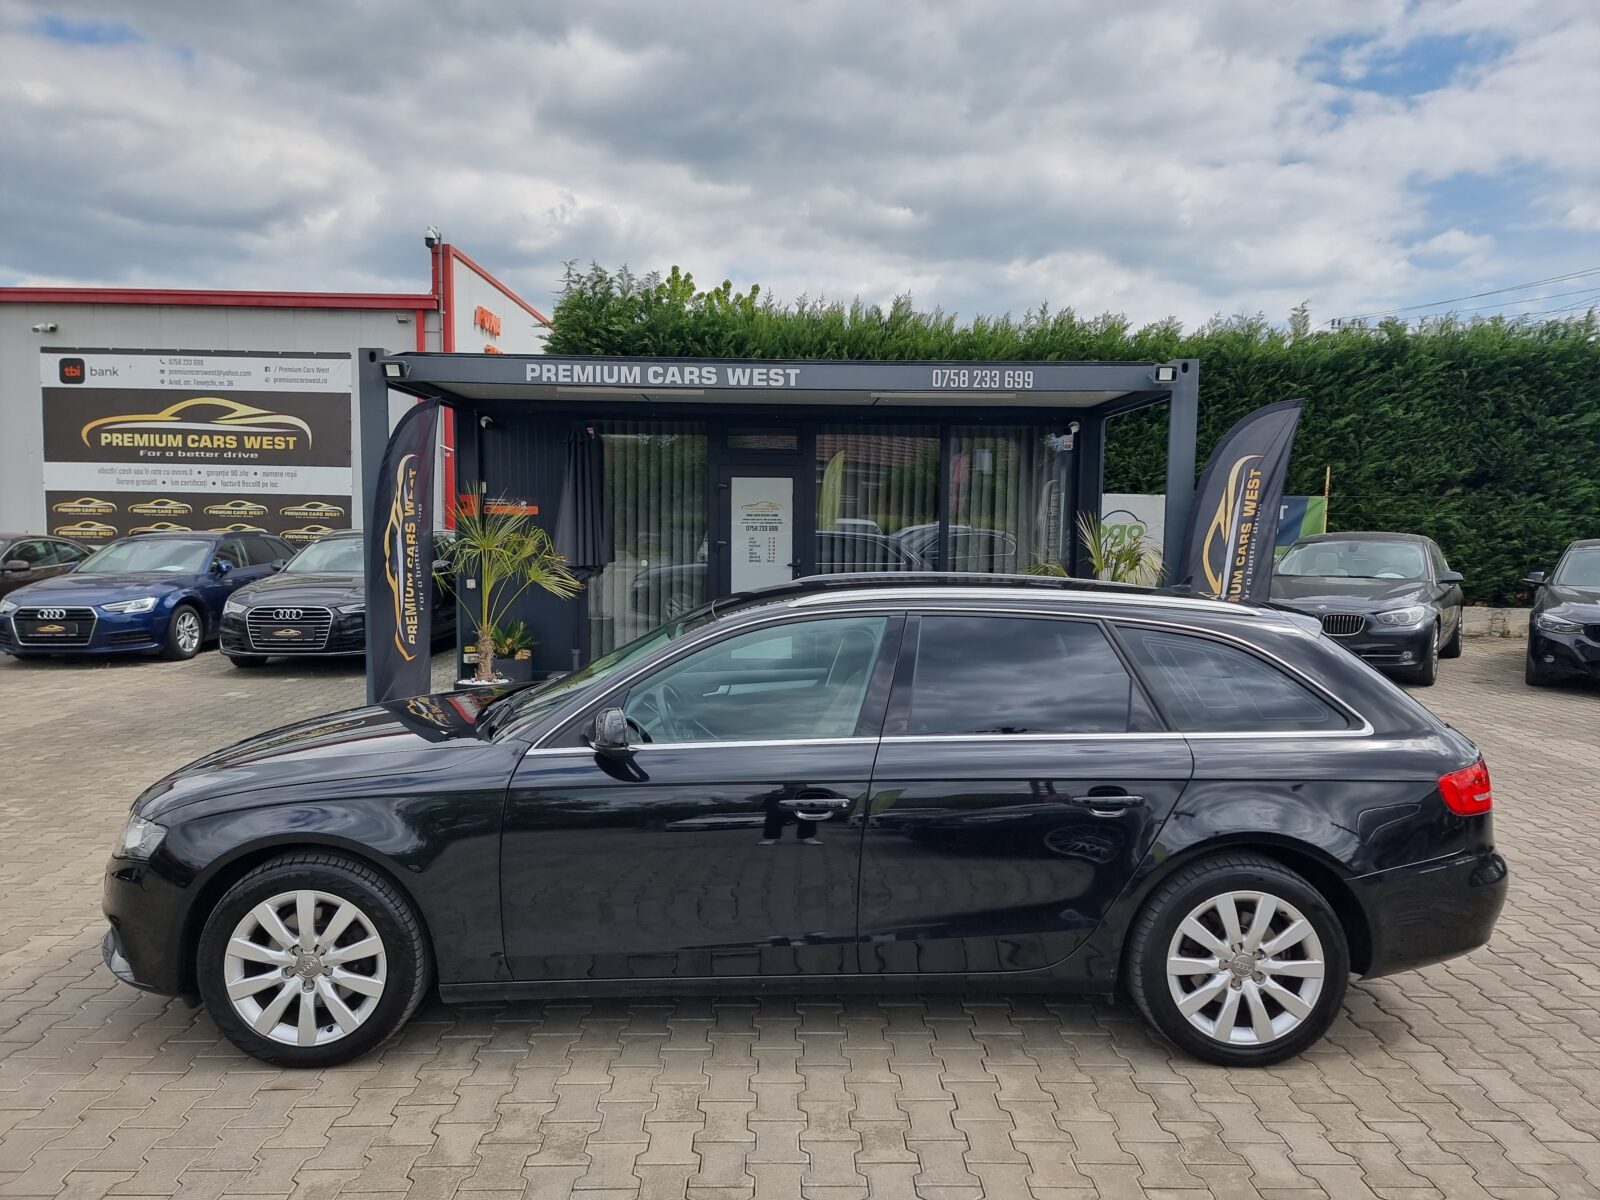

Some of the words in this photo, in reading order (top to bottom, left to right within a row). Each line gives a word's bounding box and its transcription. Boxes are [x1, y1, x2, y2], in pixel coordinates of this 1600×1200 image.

[64, 365, 81, 377] tbi
[90, 366, 119, 377] bank
[525, 363, 641, 384] PREMIUM
[647, 365, 718, 386] CARS
[726, 367, 801, 387] WEST
[932, 369, 969, 388] 0758
[973, 369, 1000, 389] 233
[1004, 370, 1034, 389] 699
[100, 432, 183, 447] PREMIUM
[187, 434, 238, 449] CARS
[243, 435, 297, 450] WEST
[1242, 468, 1262, 517] WEST
[404, 522, 416, 568] CARS
[1236, 522, 1252, 566] CARS
[1246, 536, 1256, 574] better
[404, 572, 418, 645] PREMIUM
